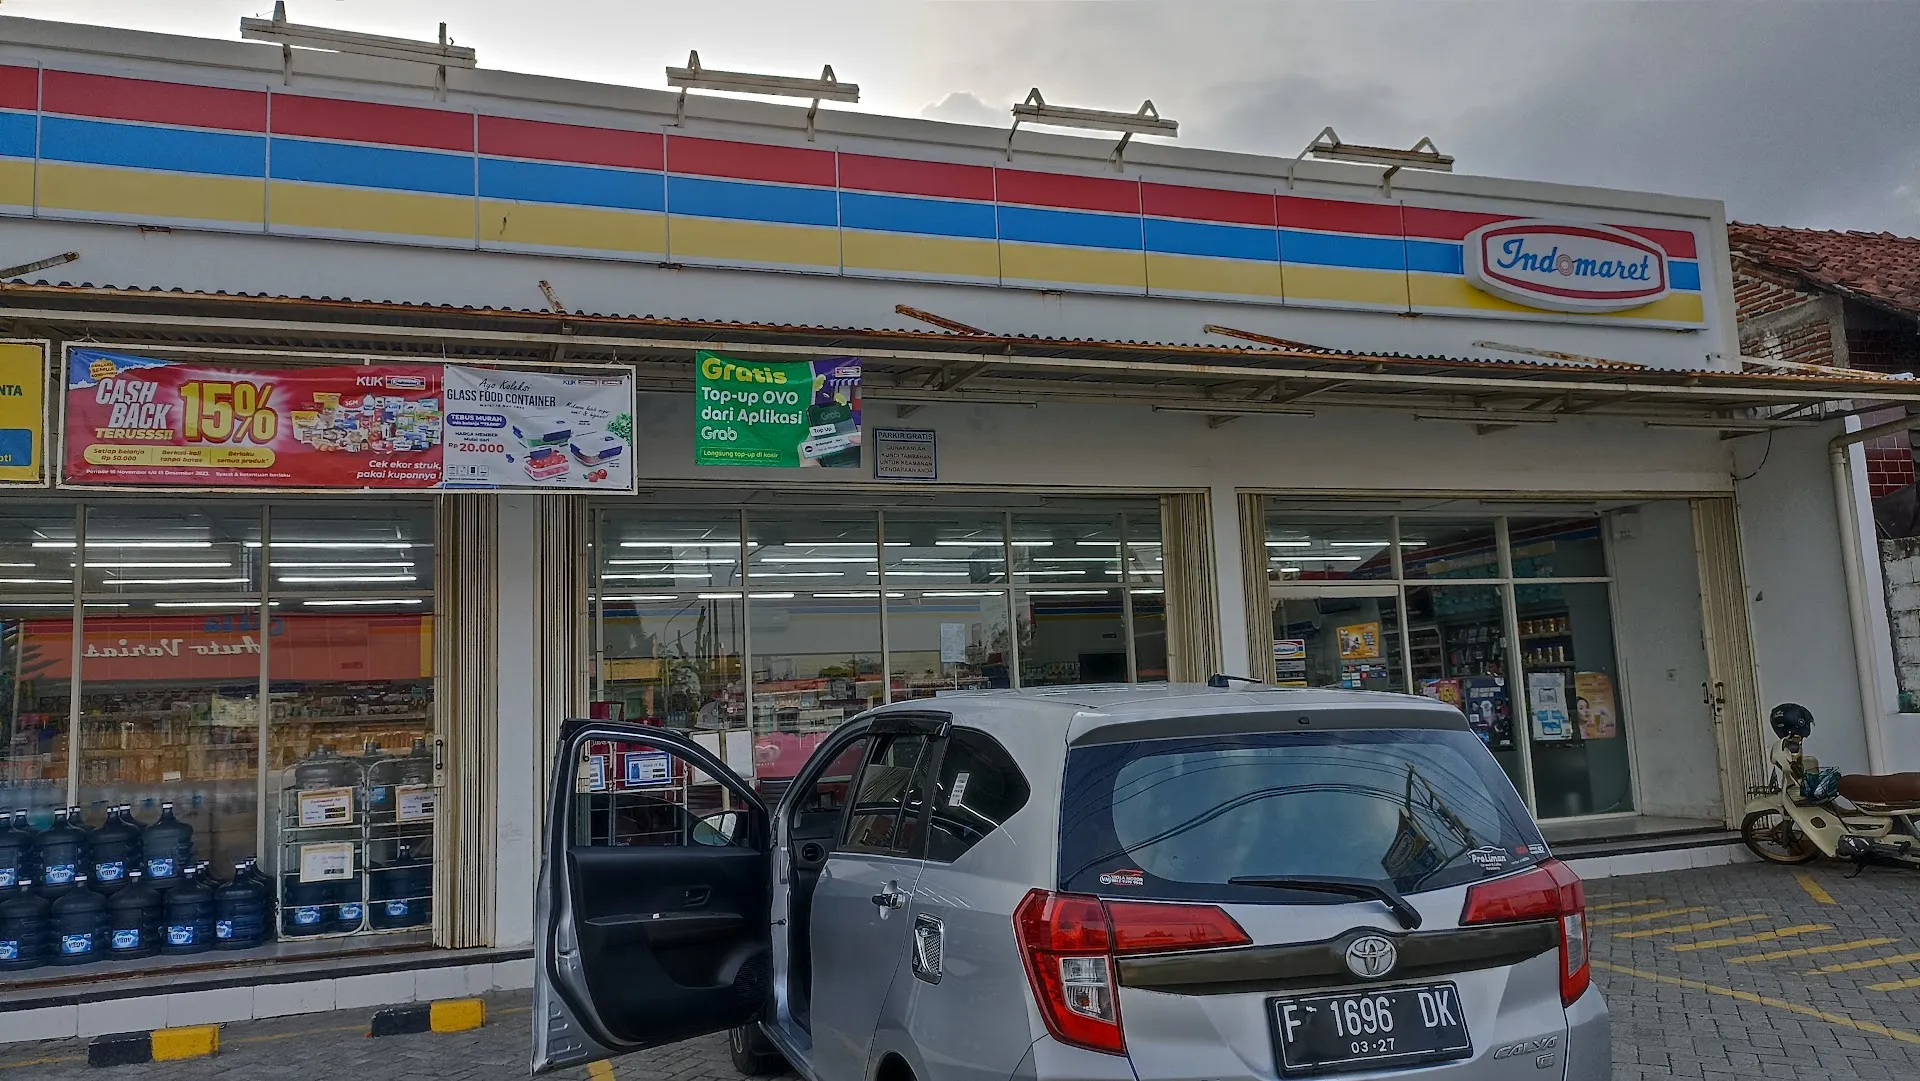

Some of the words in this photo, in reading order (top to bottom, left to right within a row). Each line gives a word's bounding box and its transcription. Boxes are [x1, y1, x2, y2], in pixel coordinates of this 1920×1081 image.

[1496, 238, 1651, 282] Indomaret
[701, 357, 788, 385] Gratis
[96, 378, 158, 405] CASH
[478, 378, 496, 390] Ayo
[499, 379, 533, 392] Koleksi
[446, 388, 477, 402] GLASS
[480, 390, 503, 403] FOOD
[505, 393, 556, 407] CONTAINER
[701, 386, 759, 407] Top-up
[762, 390, 799, 406] OVO
[108, 402, 173, 430] BACK
[179, 381, 278, 442] 15%
[701, 405, 734, 421] dari
[736, 408, 803, 426] Aplikasi
[820, 411, 841, 420] Grab
[94, 428, 174, 440] TERUSSS!!
[701, 426, 738, 441] Grab
[906, 432, 933, 440] GRATIS
[118, 448, 145, 456] belanja
[459, 443, 505, 453] 20.000
[703, 450, 734, 458] Langsung
[369, 459, 388, 468] Cek
[390, 461, 412, 469] ekor
[413, 462, 442, 470] struk,
[356, 470, 386, 480] pakai
[387, 470, 437, 481] kuponnya
[1282, 1004, 1302, 1043] F
[1330, 996, 1394, 1038] 1696
[1417, 990, 1457, 1029] DK
[1494, 1036, 1558, 1060] CALYA
